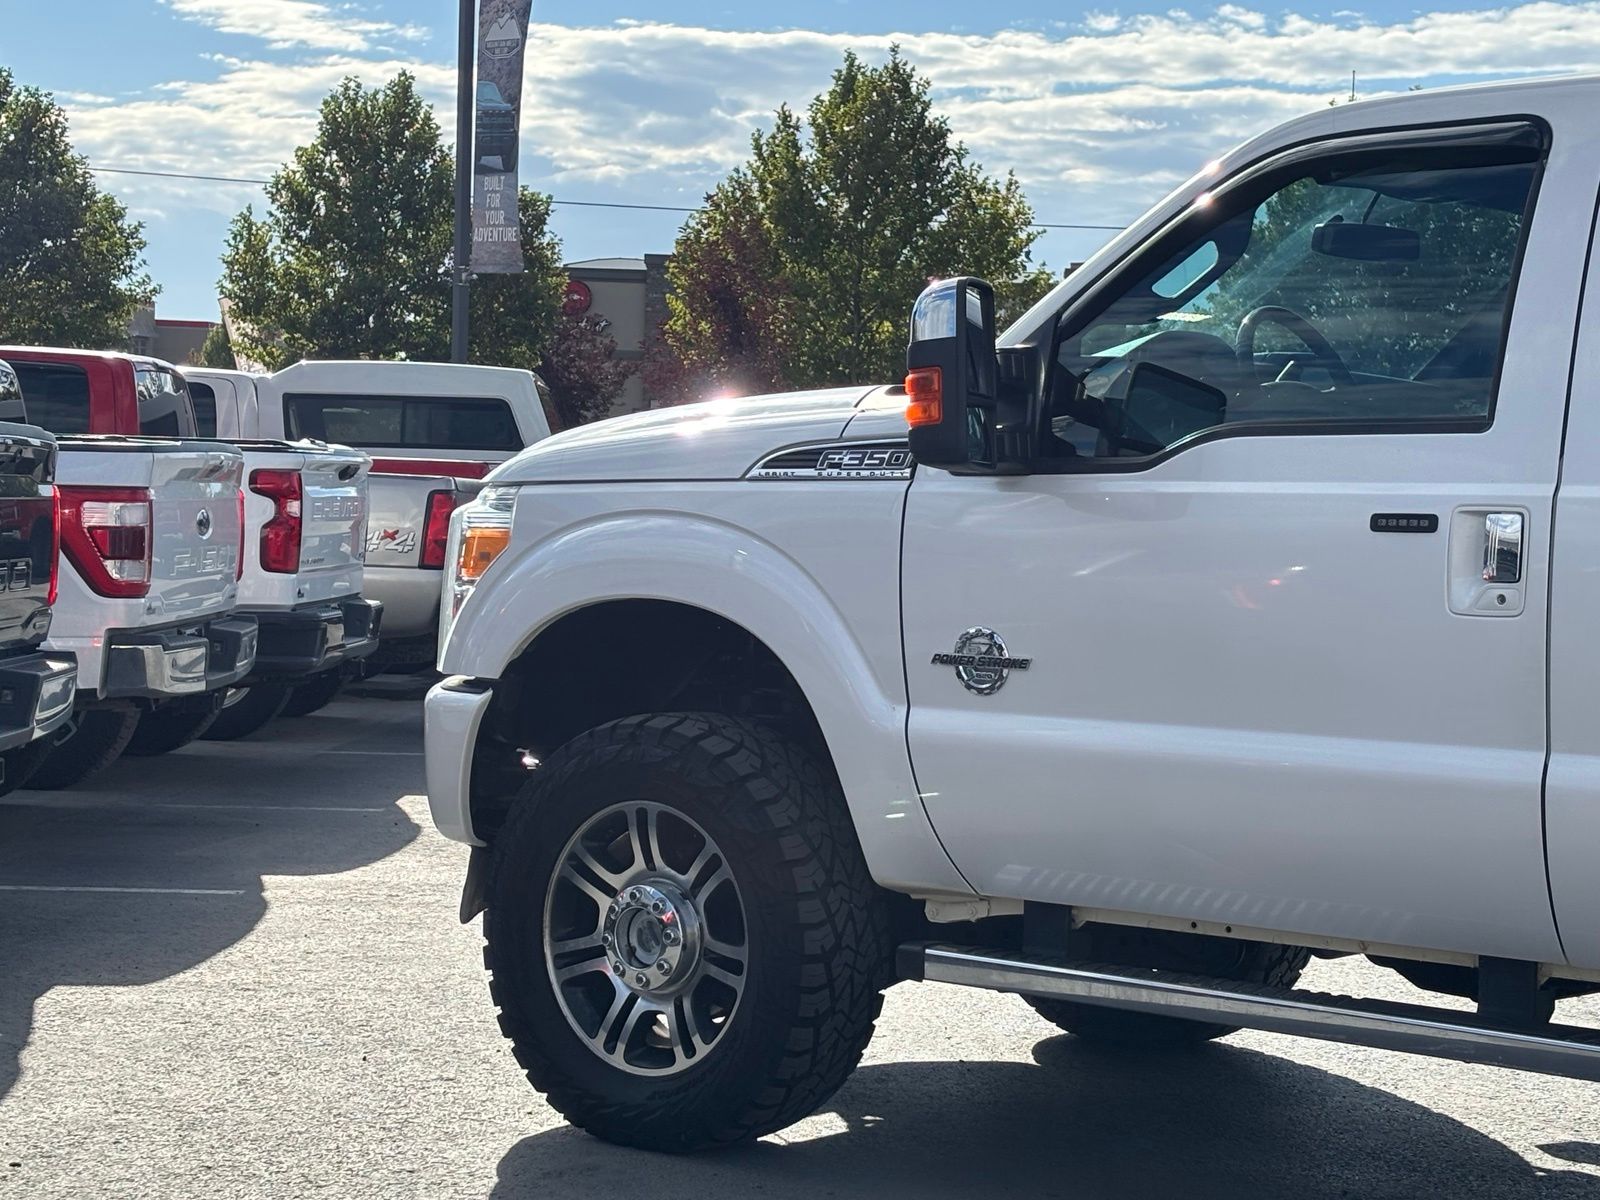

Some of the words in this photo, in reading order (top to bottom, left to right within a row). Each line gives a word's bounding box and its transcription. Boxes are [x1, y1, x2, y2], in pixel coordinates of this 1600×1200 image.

[483, 175, 505, 191] BUILT
[486, 193, 501, 208] FOR
[485, 210, 505, 225] YOUR
[473, 227, 517, 242] ADVENTURE
[930, 653, 976, 666] POWER
[976, 656, 1031, 670] STROKE
